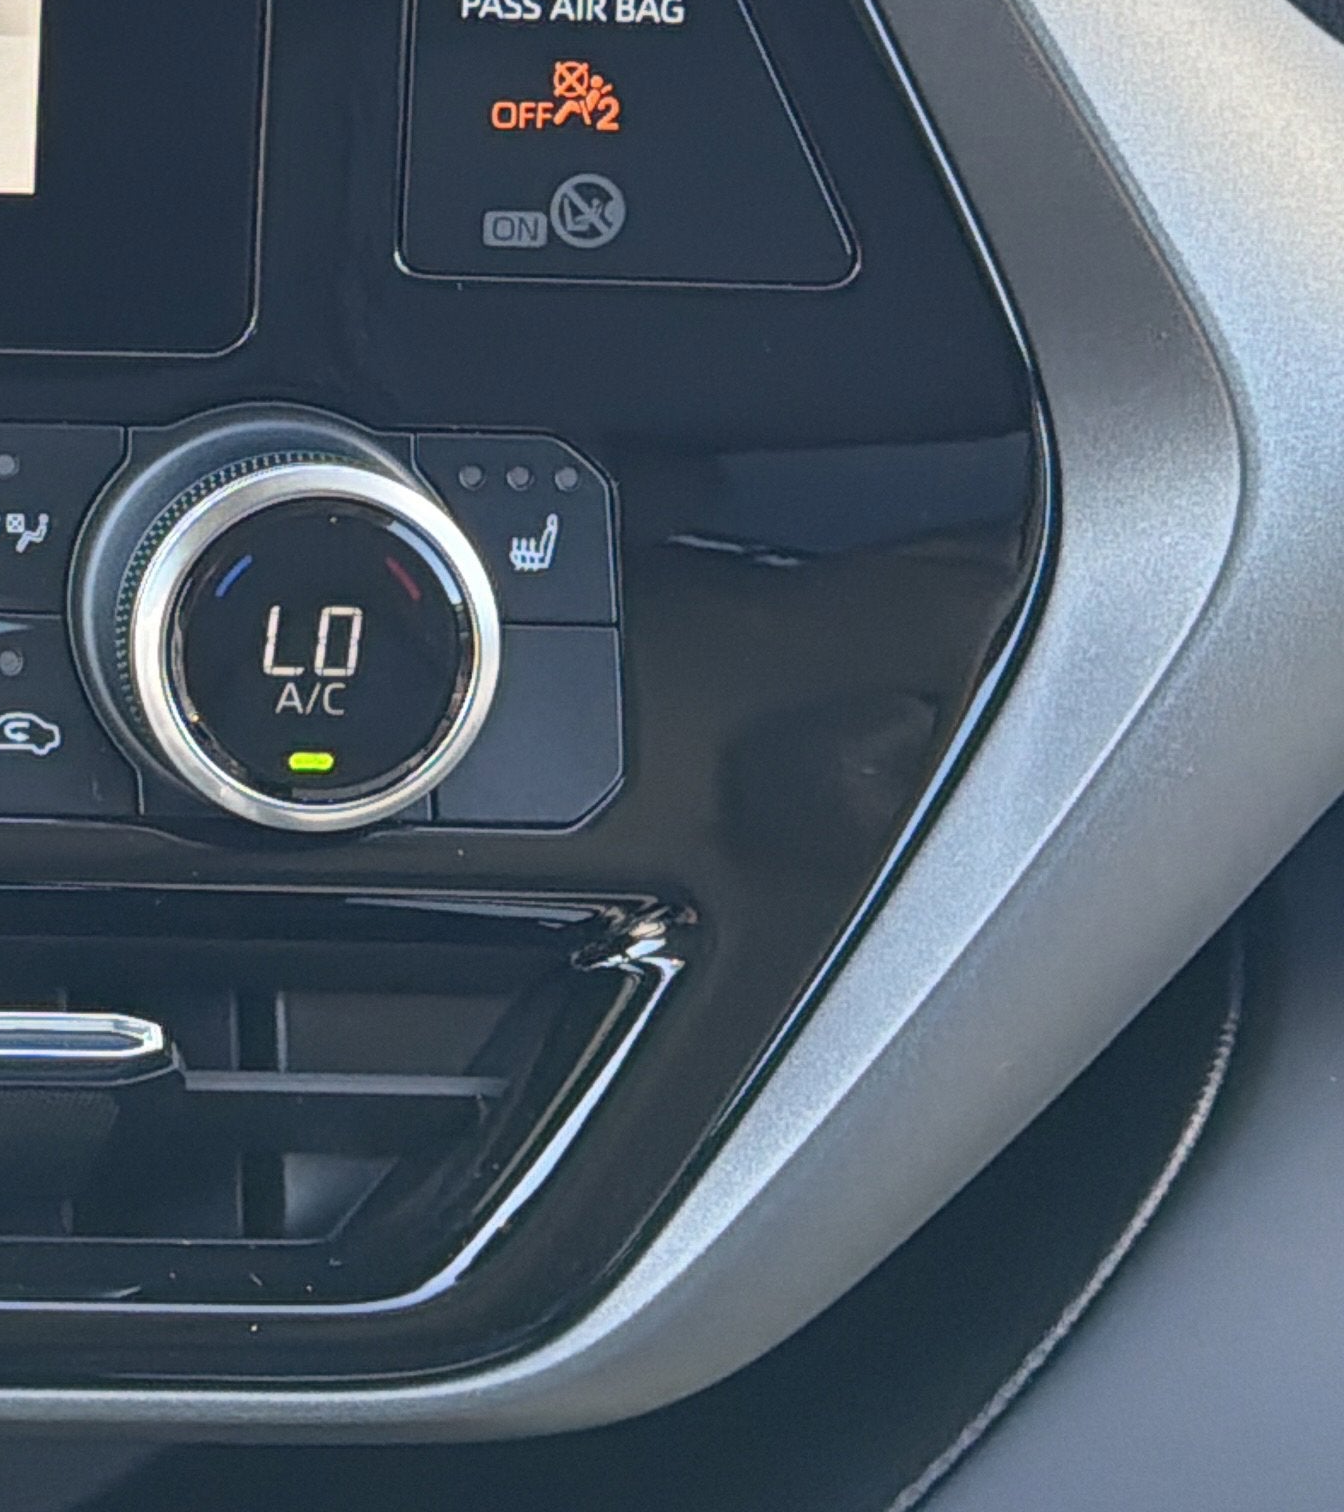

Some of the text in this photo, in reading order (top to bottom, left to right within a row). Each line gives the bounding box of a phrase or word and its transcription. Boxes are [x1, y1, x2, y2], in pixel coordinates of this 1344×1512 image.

[491, 101, 553, 129] OFF
[492, 216, 539, 242] ON
[275, 682, 346, 715] A/C
